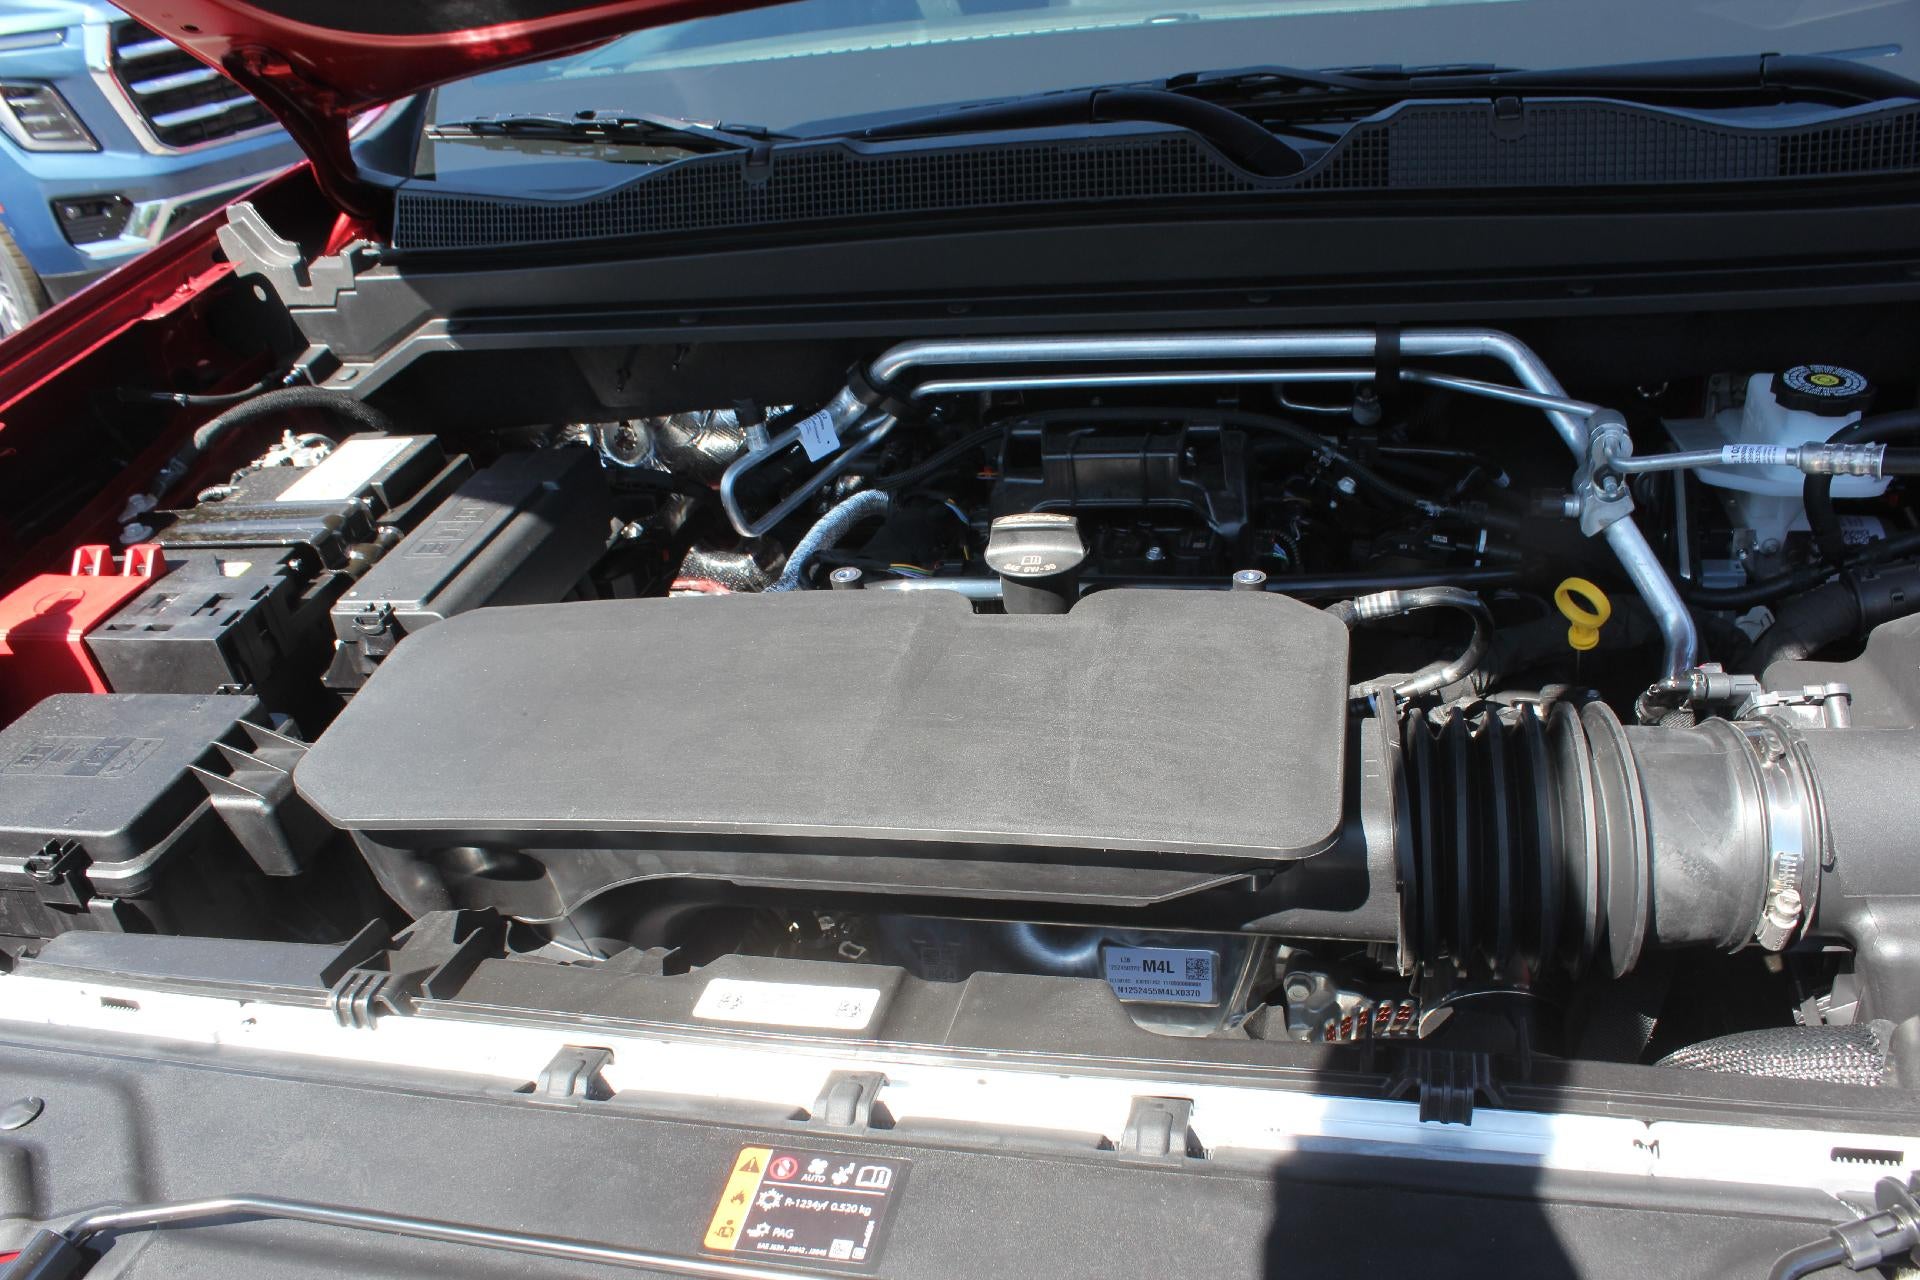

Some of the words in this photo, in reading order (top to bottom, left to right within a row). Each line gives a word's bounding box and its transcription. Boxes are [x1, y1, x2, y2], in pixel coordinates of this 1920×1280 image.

[1142, 960, 1175, 974] M4L
[801, 1174, 825, 1183] AUTO
[785, 1198, 829, 1211] R-1234yf
[831, 1203, 858, 1213] 0.520
[859, 1205, 871, 1216] kg
[773, 1228, 794, 1239] PAG
[757, 1242, 769, 1250] SAE
